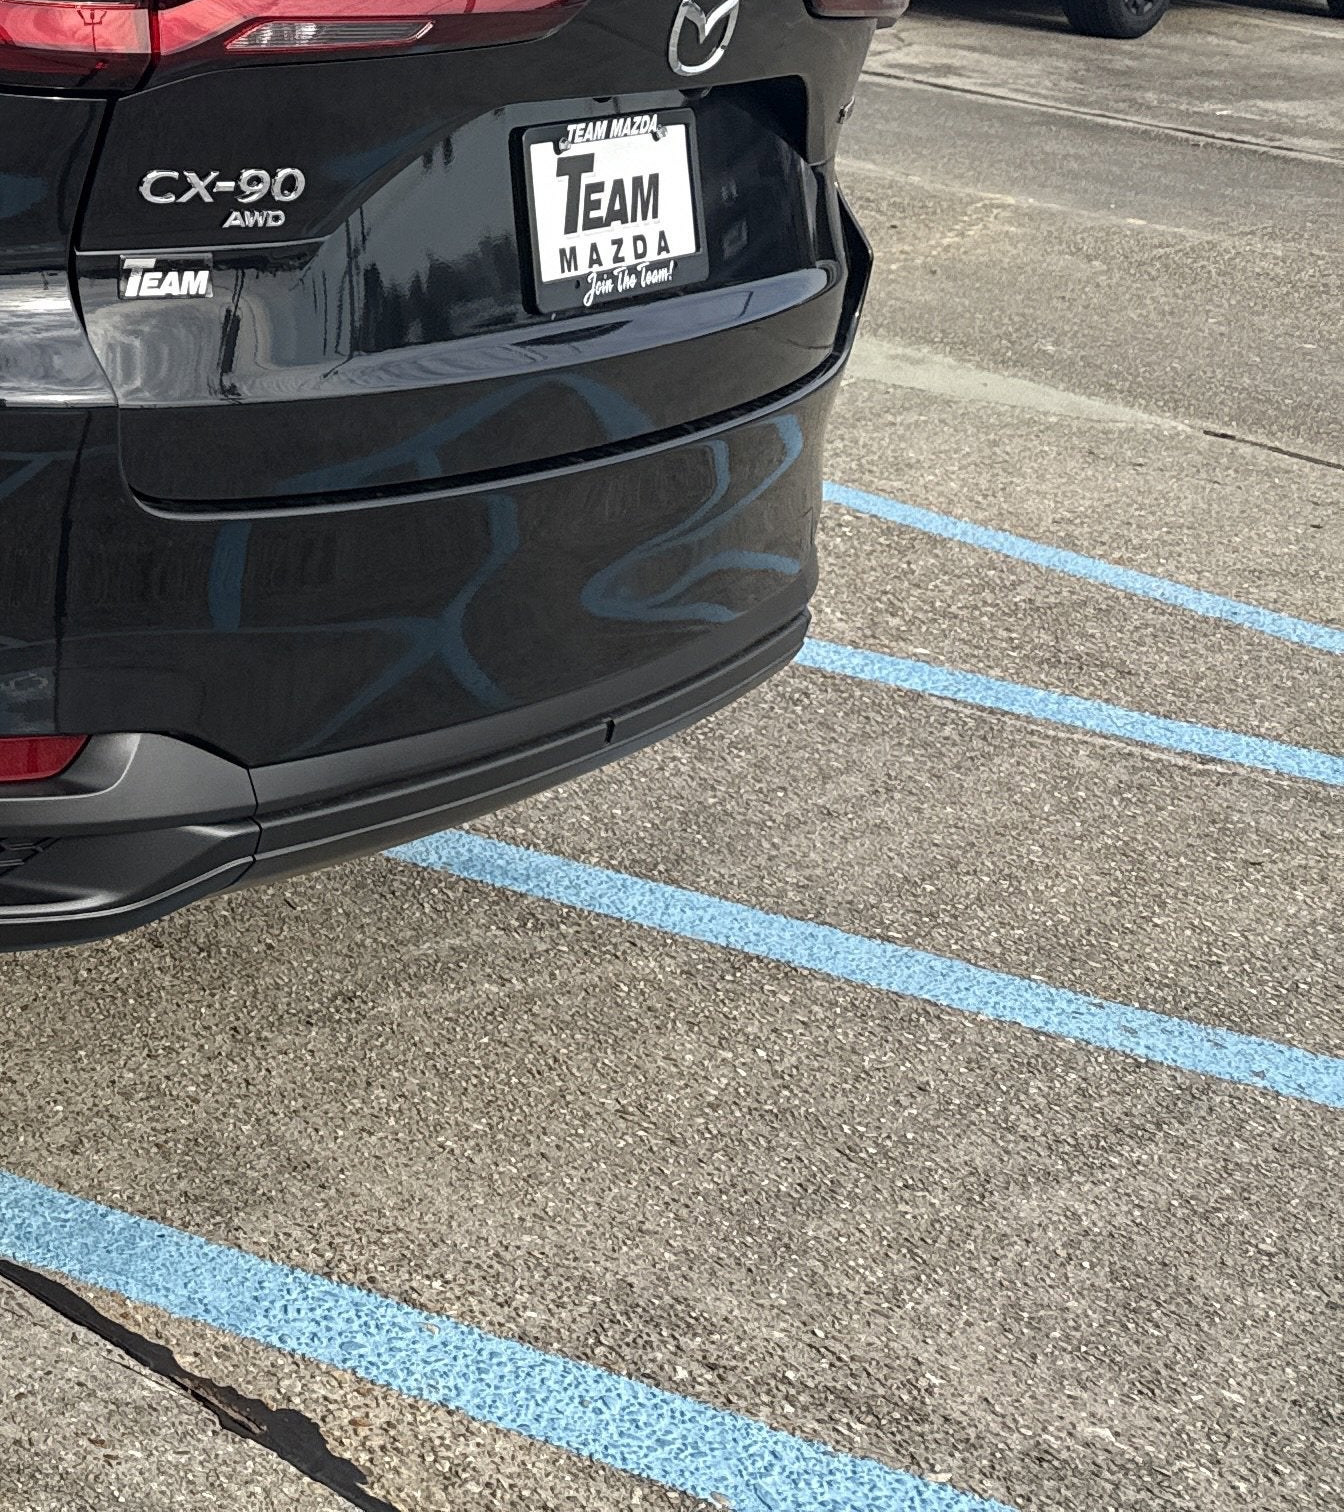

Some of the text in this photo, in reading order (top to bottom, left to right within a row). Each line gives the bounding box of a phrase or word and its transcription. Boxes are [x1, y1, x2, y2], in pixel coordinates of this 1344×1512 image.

[567, 113, 658, 144] TEAM MAZDA
[138, 167, 306, 204] CX-90
[555, 153, 660, 235] TEAM
[222, 209, 286, 228] AWD
[559, 230, 671, 274] MAZDA
[123, 257, 210, 297] TEAM
[583, 261, 674, 307] Join The Team!
